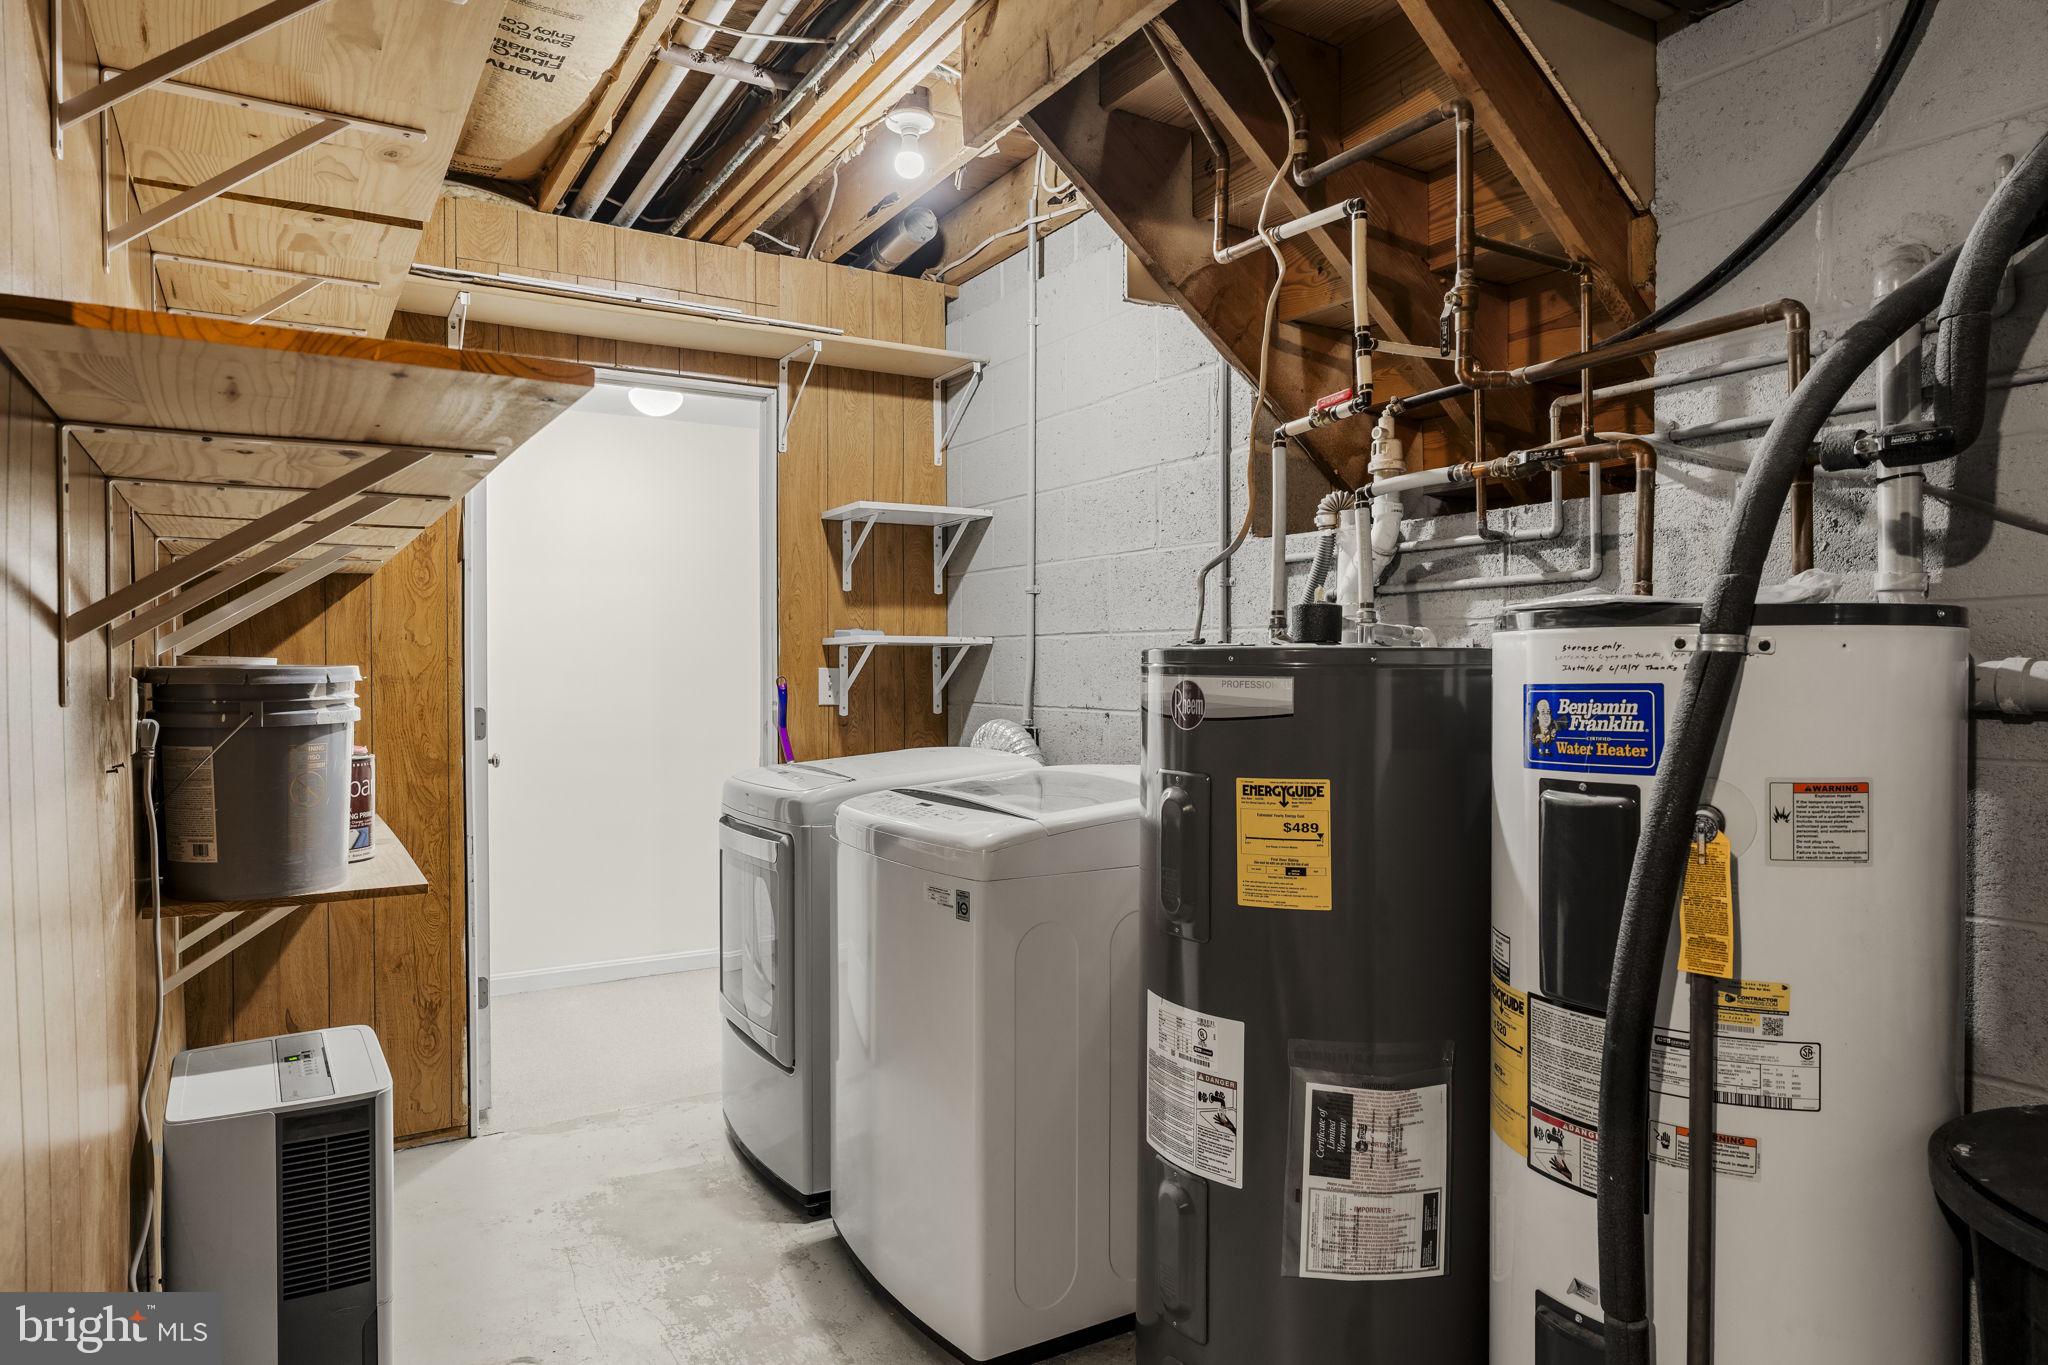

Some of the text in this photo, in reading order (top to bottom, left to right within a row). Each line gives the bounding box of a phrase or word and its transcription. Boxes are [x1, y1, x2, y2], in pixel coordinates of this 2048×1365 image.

[533, 27, 576, 42] Enjoy
[534, 35, 572, 48] Save
[491, 45, 563, 70] FiberG
[494, 37, 566, 62] Insulati
[1174, 681, 1203, 721] Rheem
[1557, 698, 1638, 720] Benjamin
[1568, 715, 1645, 732] Franklin
[1556, 742, 1648, 757] Water Heater
[1242, 784, 1325, 798] ENERGYGUIDE
[1283, 822, 1319, 833] $489
[1737, 995, 1778, 1003] CONTRACTOR
[1205, 1075, 1235, 1088] DANGER
[1316, 1106, 1328, 1158] Certificate of
[1327, 1119, 1337, 1150] Limited
[1337, 1118, 1349, 1153] Warranty
[1354, 1206, 1392, 1214] IMPORTANTE
